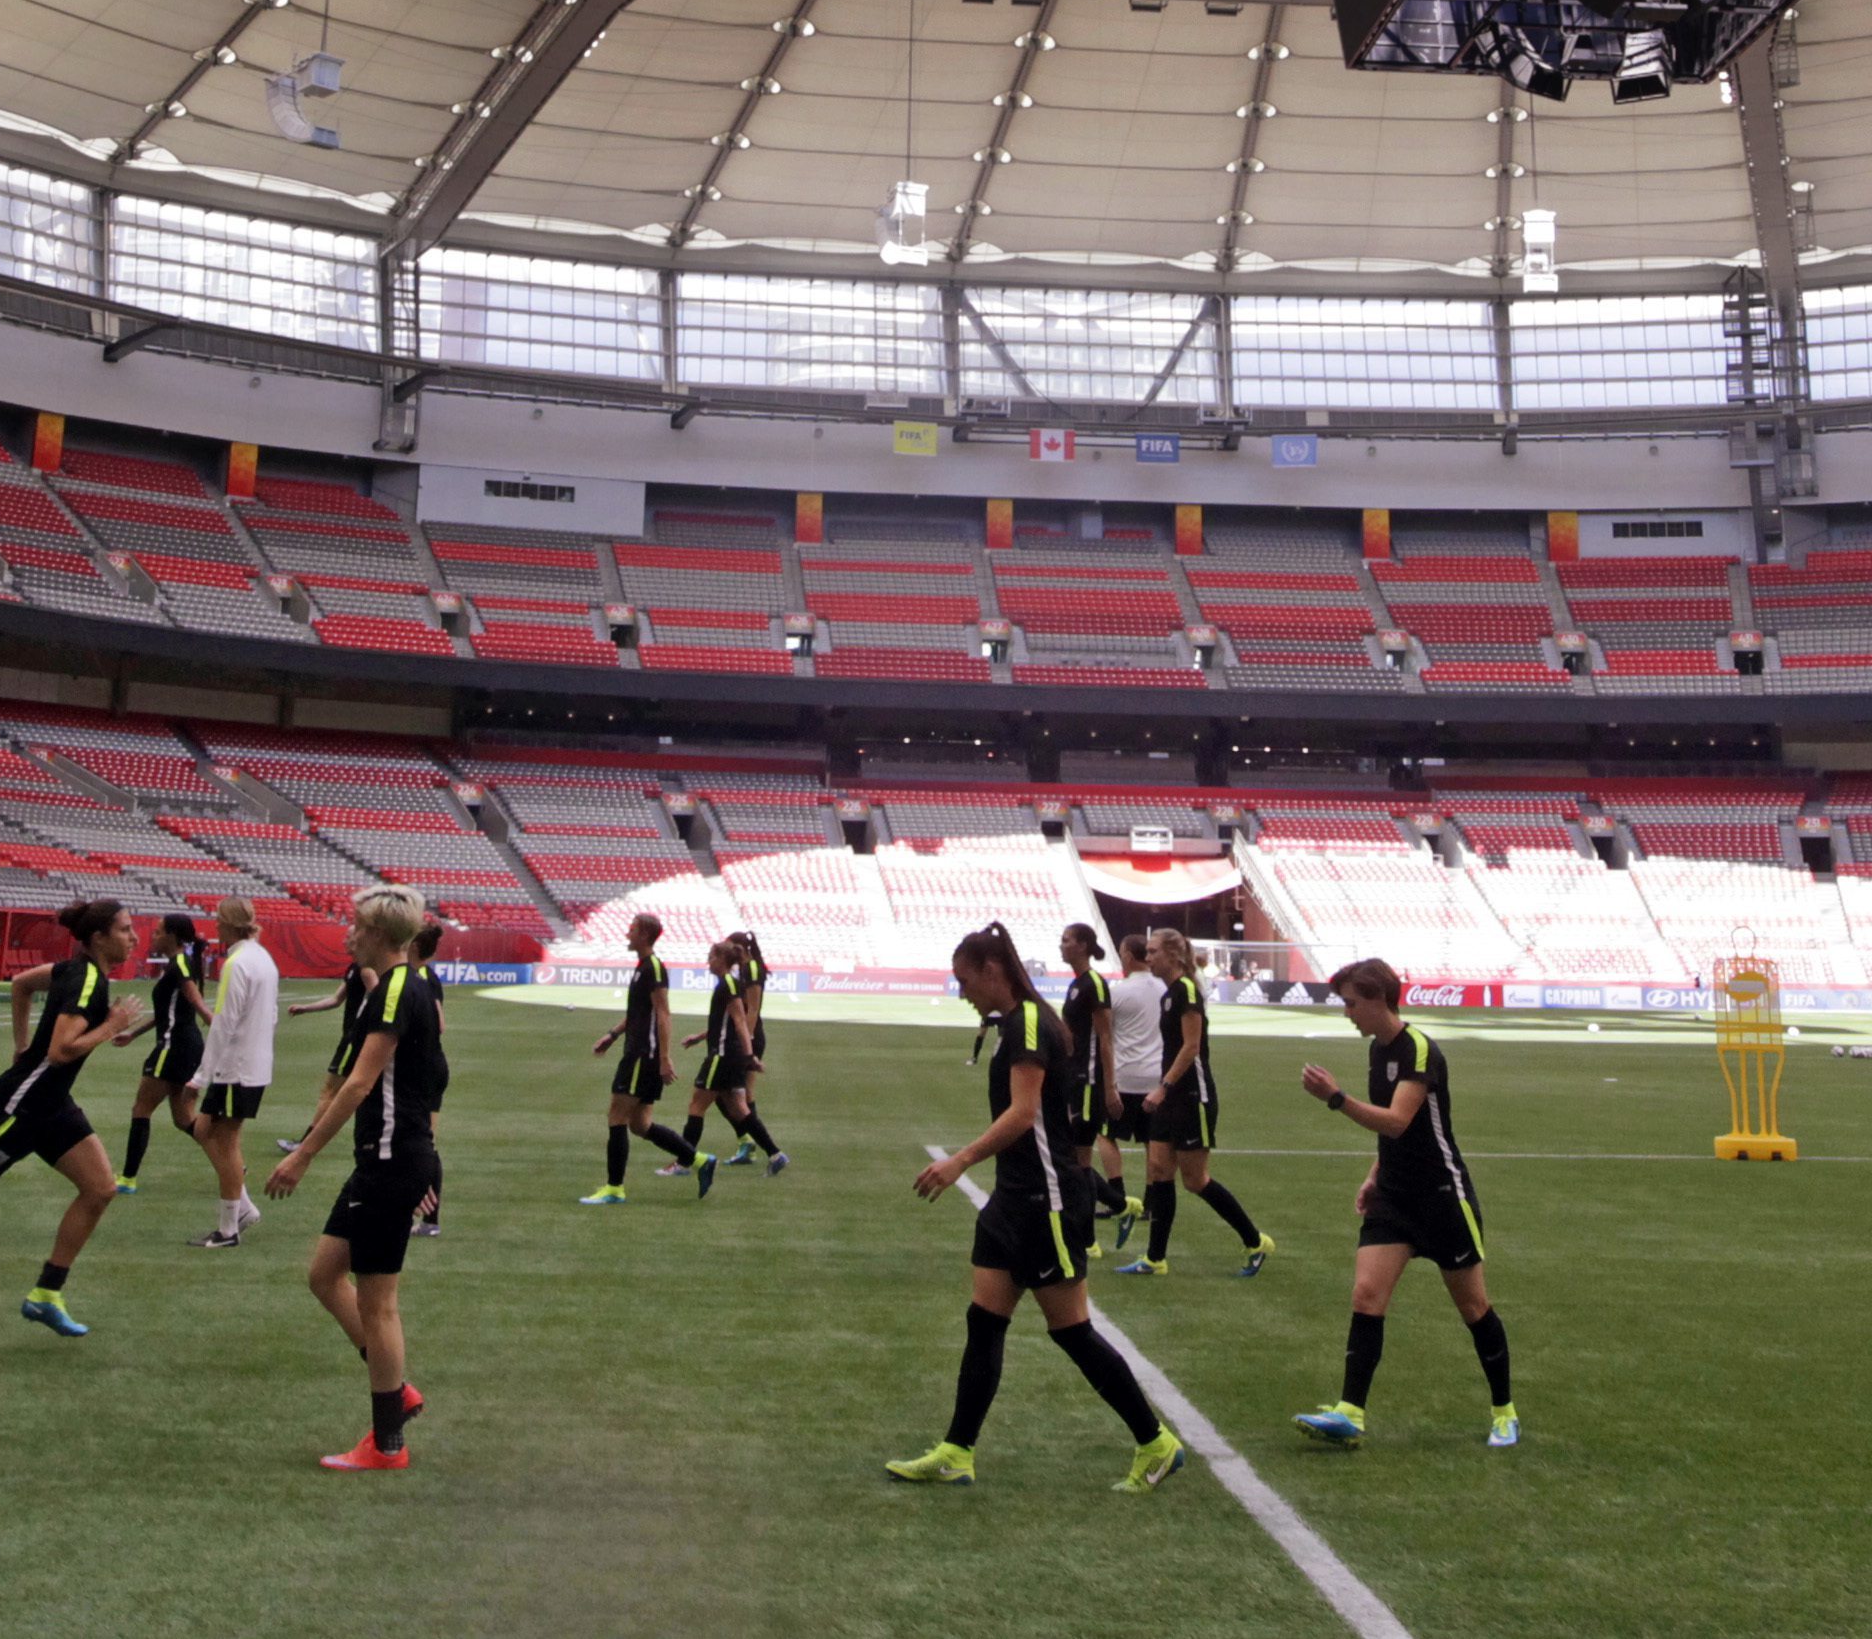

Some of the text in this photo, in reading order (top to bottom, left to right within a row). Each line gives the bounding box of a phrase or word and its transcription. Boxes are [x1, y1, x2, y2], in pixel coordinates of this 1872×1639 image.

[1141, 440, 1173, 453] FIFA
[434, 963, 517, 982] FIFA.com
[561, 968, 613, 984] TREND
[811, 975, 885, 991] Budweiser
[1544, 989, 1601, 1006] GAZPROM
[1784, 993, 1817, 1007] FIFA
